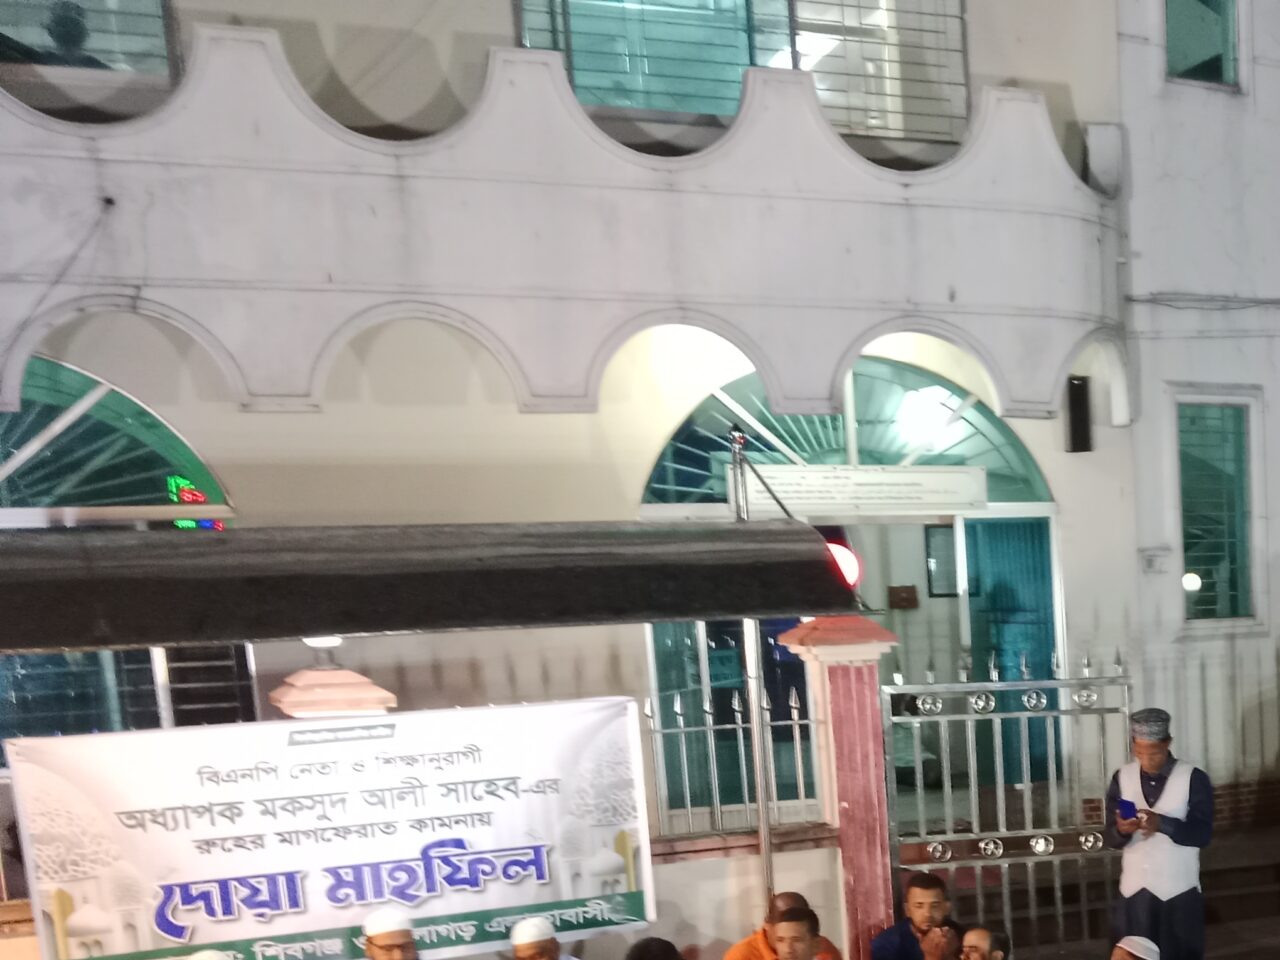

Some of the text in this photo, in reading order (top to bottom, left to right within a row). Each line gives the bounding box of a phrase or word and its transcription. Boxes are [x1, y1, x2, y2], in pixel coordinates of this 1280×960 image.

[197, 763, 278, 786] বিএনপি
[115, 801, 244, 832] অধ্যাপক
[254, 792, 348, 821] মকসুদ
[360, 776, 428, 809] আলী
[193, 812, 493, 854] রুহের মাগফেরাত কামনায়
[153, 838, 550, 942] দোয়া মাহফিল
